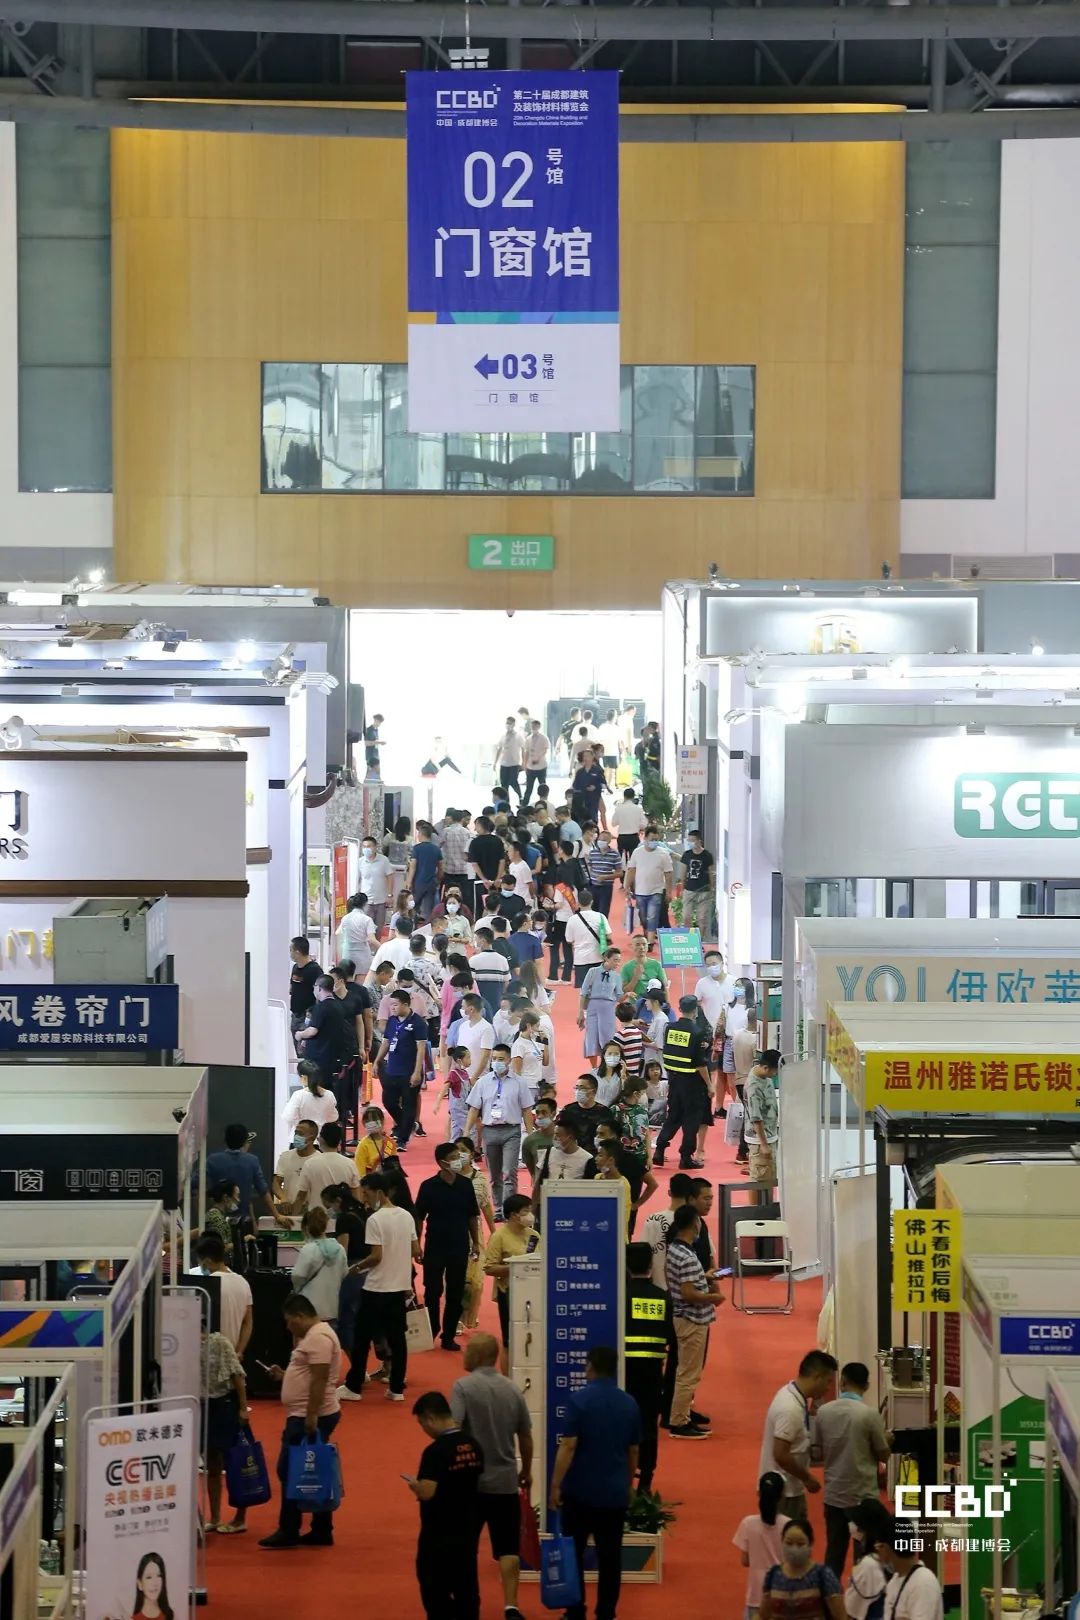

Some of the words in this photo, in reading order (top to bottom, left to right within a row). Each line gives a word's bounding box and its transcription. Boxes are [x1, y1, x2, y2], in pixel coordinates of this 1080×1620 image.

[437, 91, 498, 108] CCBD
[464, 151, 534, 208] 02
[547, 148, 564, 185] 号馆
[434, 226, 592, 278] 门窗馆
[502, 353, 537, 380] 03
[542, 353, 555, 380] 号馆
[482, 540, 502, 565] 2
[511, 541, 540, 555] 出口
[511, 557, 537, 566] EXIT
[884, 1060, 1080, 1091] 温州雅诺氏锁
[905, 1219, 926, 1303] 佛山推拉门
[931, 1219, 951, 1303] 不看你后悔
[1028, 1325, 1073, 1339] CCBD
[105, 1453, 176, 1487] CCTV
